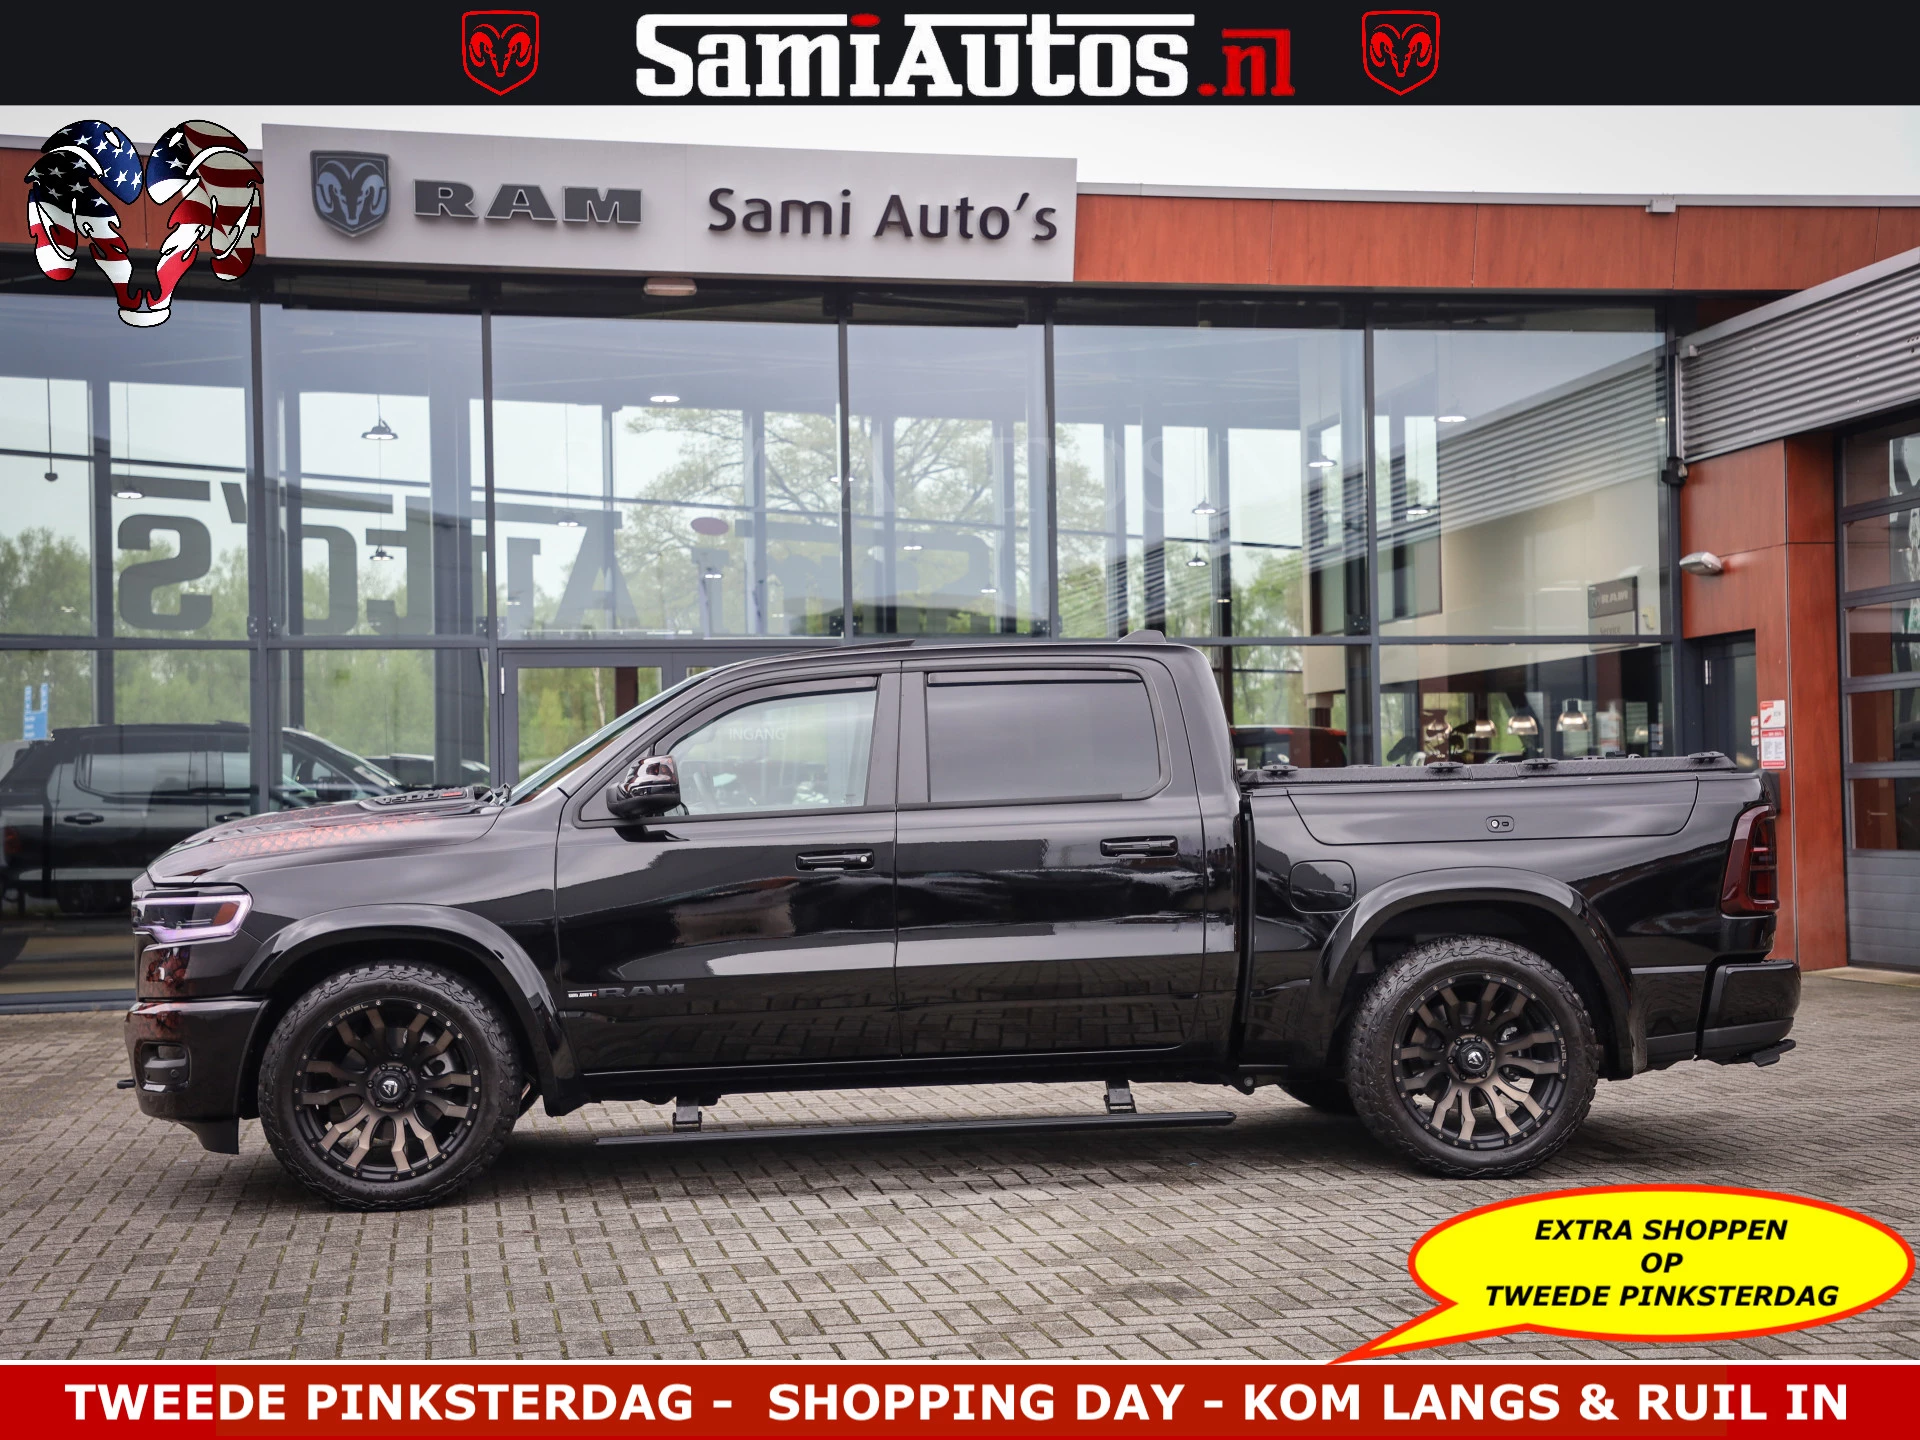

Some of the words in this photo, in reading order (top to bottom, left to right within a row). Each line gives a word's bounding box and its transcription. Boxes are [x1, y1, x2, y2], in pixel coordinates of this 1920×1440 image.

[413, 178, 643, 225] RAM
[708, 187, 852, 237] Sami
[875, 192, 1058, 241] Auto's
[1601, 590, 1629, 604] RAM
[729, 727, 786, 741] INGANG
[598, 983, 685, 999] RAM
[339, 1003, 369, 1019] FUEL
[1558, 1037, 1568, 1067] FUEL
